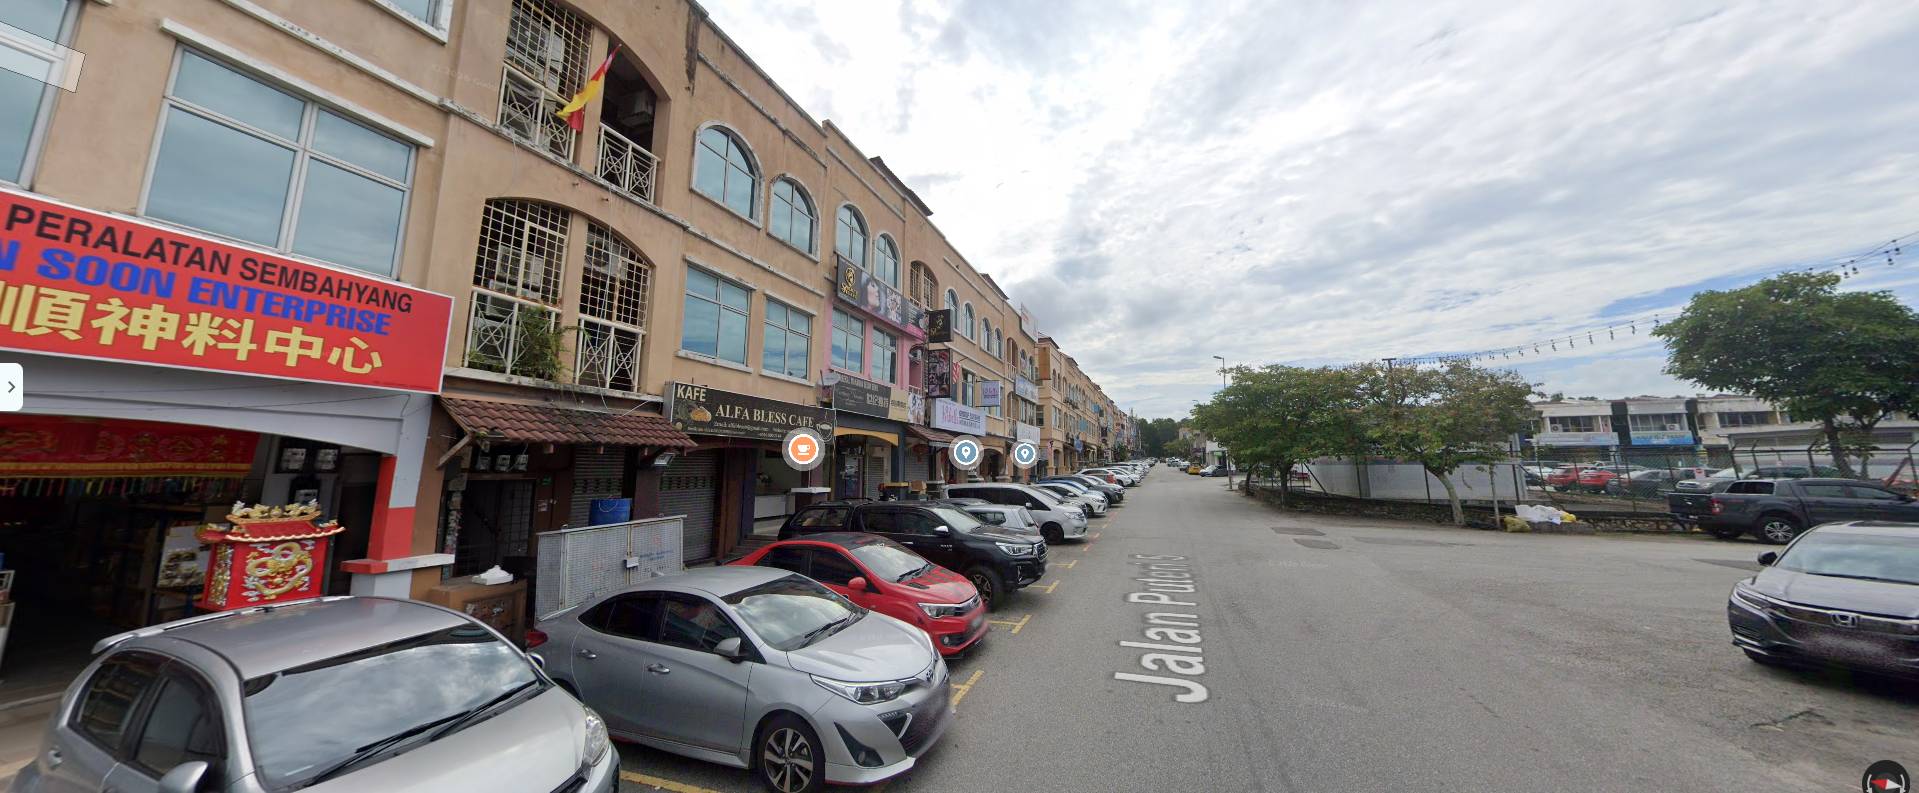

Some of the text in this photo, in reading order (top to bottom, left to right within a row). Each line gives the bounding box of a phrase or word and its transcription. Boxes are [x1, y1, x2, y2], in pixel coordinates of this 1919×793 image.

[5, 203, 413, 313] PERALATAN SEMBAHYANG
[38, 247, 175, 298] SOON
[187, 276, 391, 336] ENTERPRISE
[715, 404, 750, 420] ALFA
[753, 408, 787, 424] BLESS
[788, 413, 815, 428] CAFE
